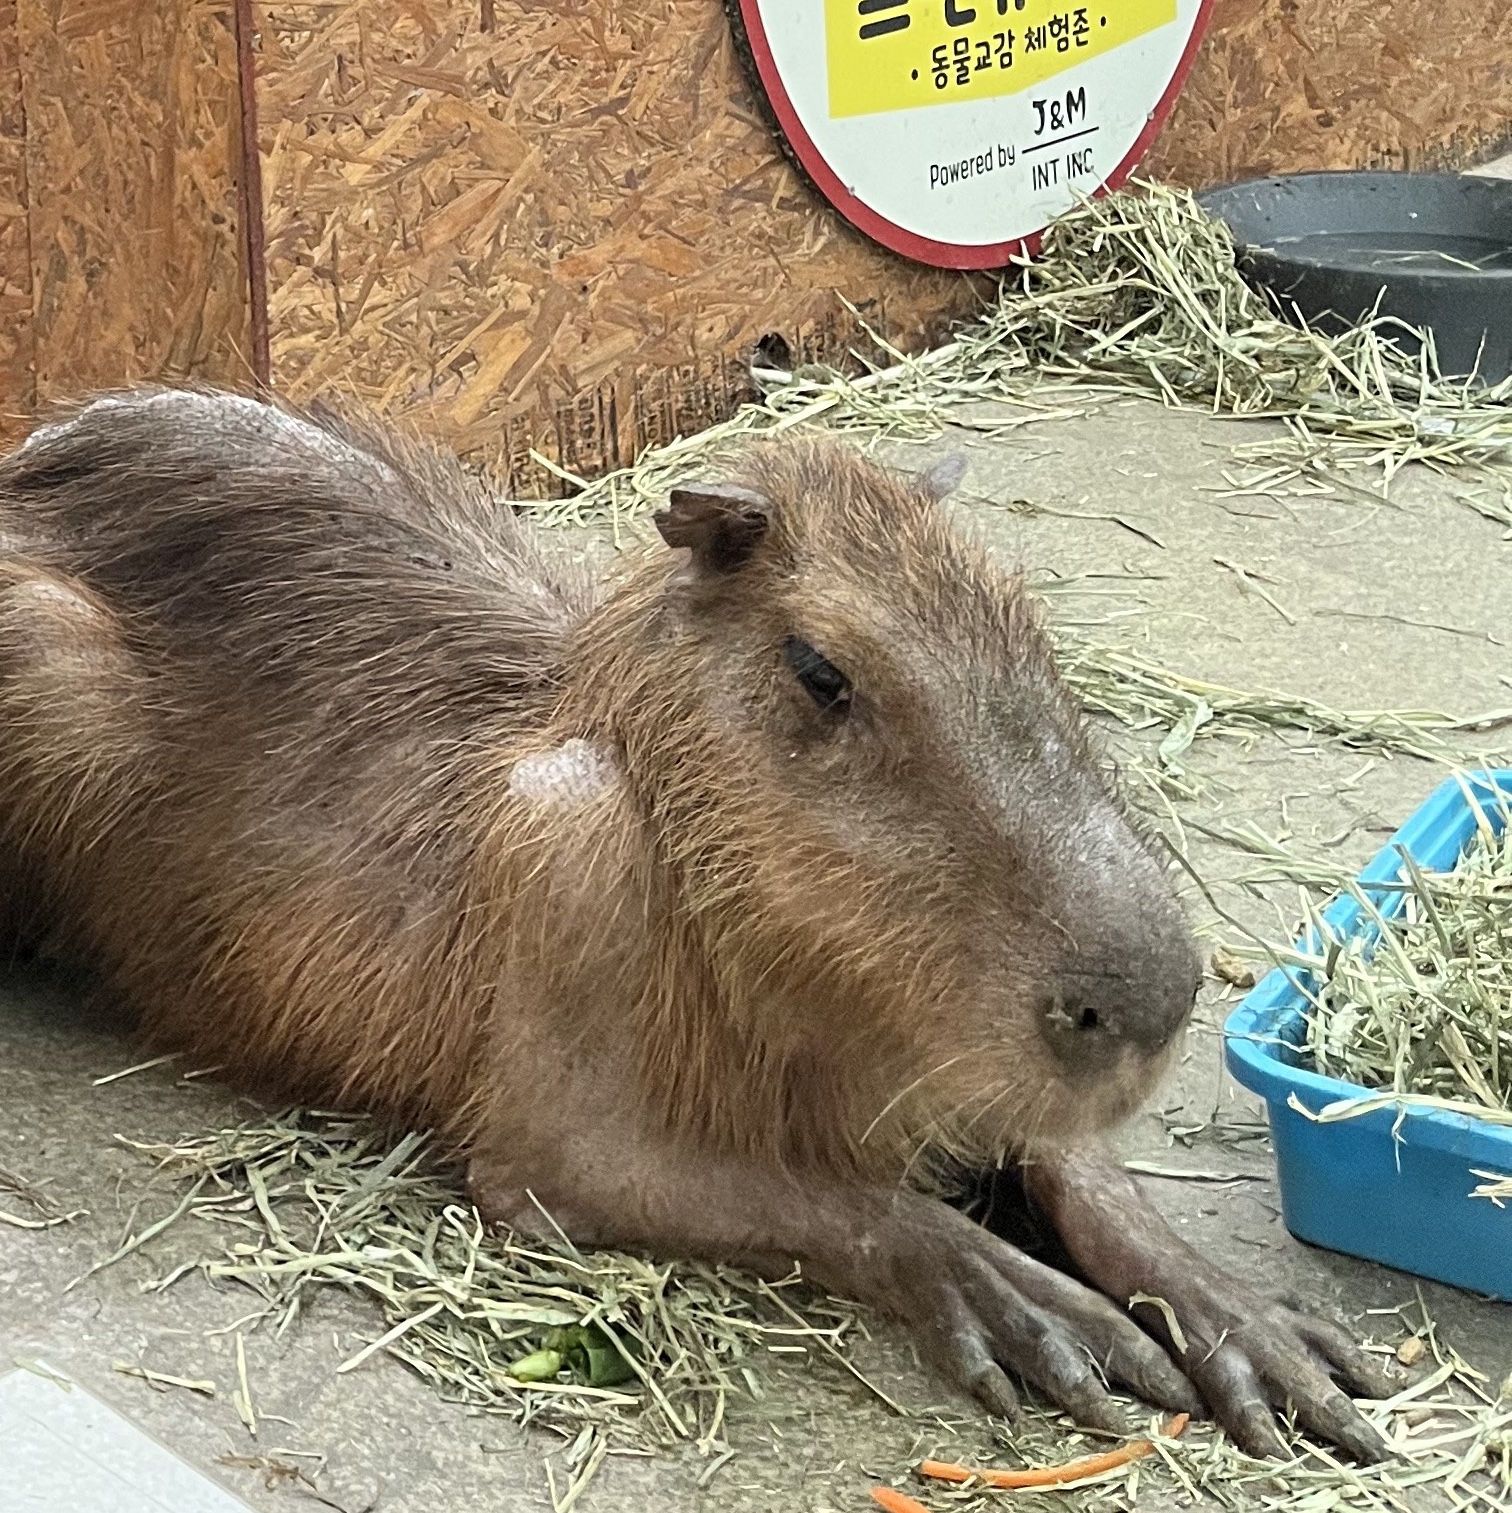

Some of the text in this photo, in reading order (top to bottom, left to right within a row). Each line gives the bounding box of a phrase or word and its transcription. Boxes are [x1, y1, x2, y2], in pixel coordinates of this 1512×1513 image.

[931, 8, 1091, 90] 동물교감 체험존
[1031, 86, 1087, 136] J&M
[929, 143, 1016, 190] Powered by
[1032, 147, 1096, 191] INT INC
